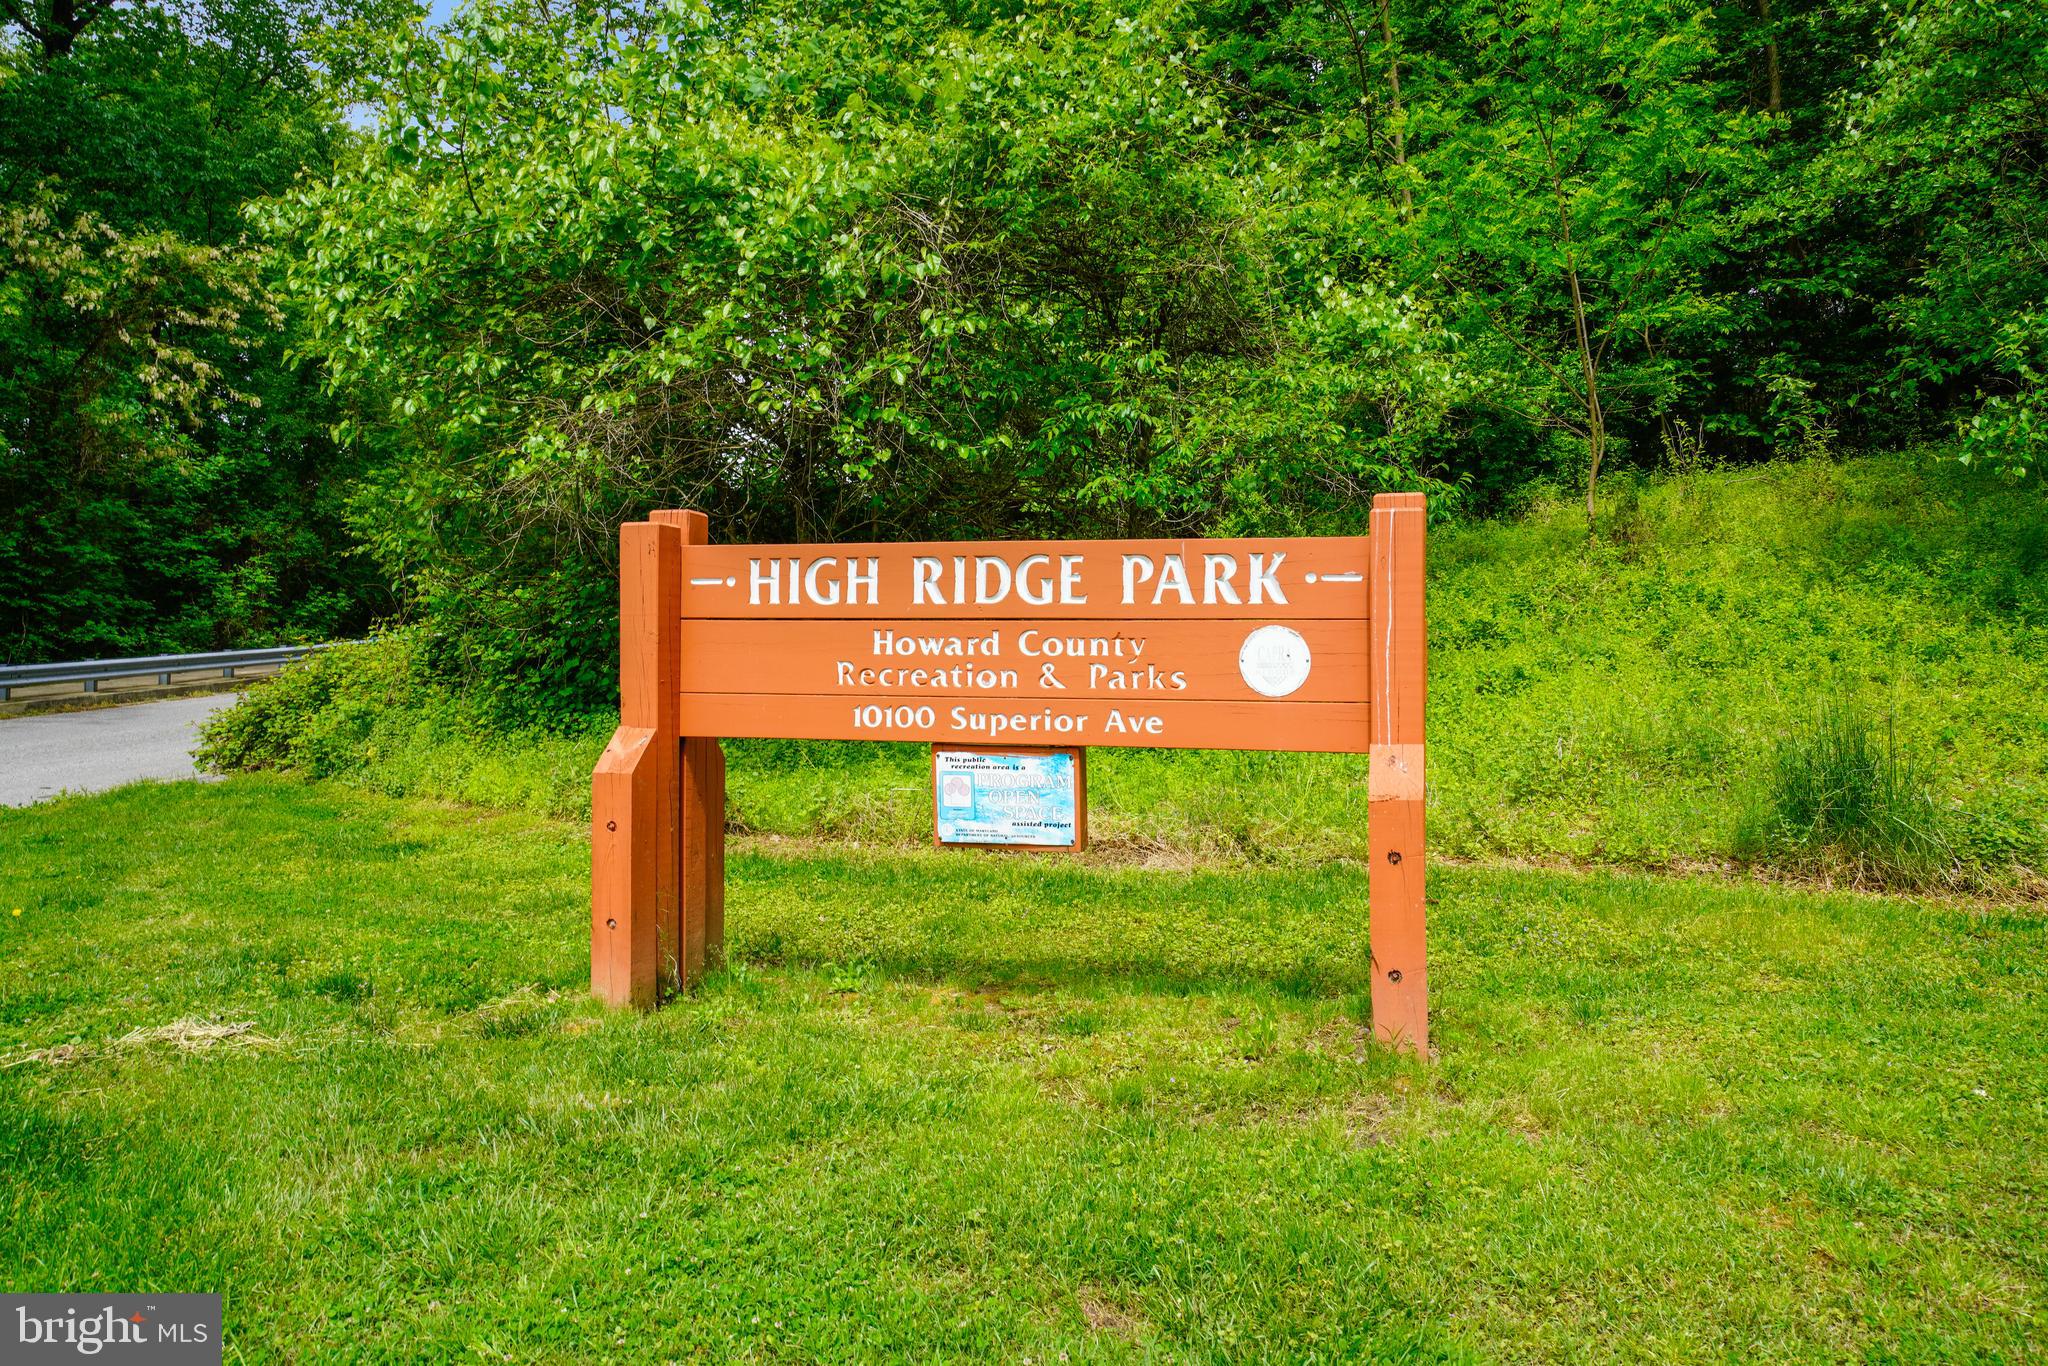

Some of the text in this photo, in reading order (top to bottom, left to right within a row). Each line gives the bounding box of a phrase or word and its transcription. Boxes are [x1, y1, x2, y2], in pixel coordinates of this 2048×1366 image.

[748, 551, 1290, 605] HIGH RIDGE PARK
[872, 629, 1146, 664] Howard County
[836, 661, 1187, 691] Recreation & Parks
[852, 705, 1164, 737] 10100 Superior Ave
[977, 774, 1071, 789] PROGRAM
[988, 789, 1040, 804] OPEN
[1003, 805, 1063, 820] SPACE
